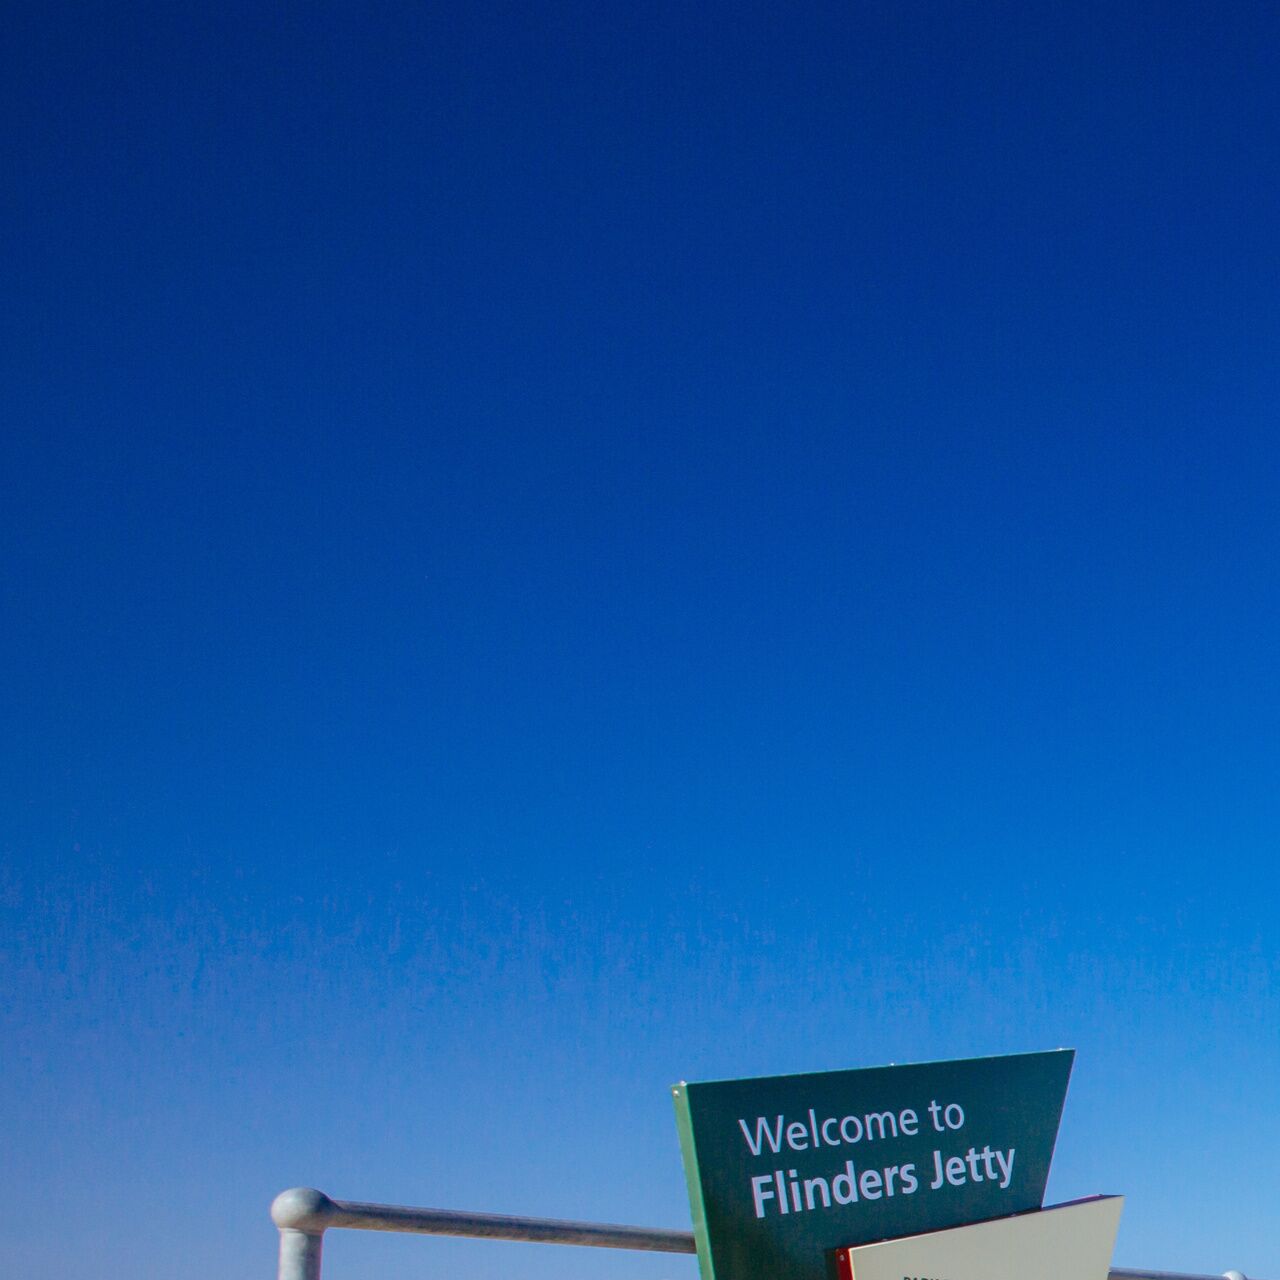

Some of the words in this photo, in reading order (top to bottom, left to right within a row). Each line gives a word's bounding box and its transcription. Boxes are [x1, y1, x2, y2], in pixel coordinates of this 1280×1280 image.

[738, 1108, 919, 1156] Welcome
[928, 1100, 965, 1132] to
[751, 1160, 919, 1219] Flinders
[930, 1145, 1016, 1190] Jetty
